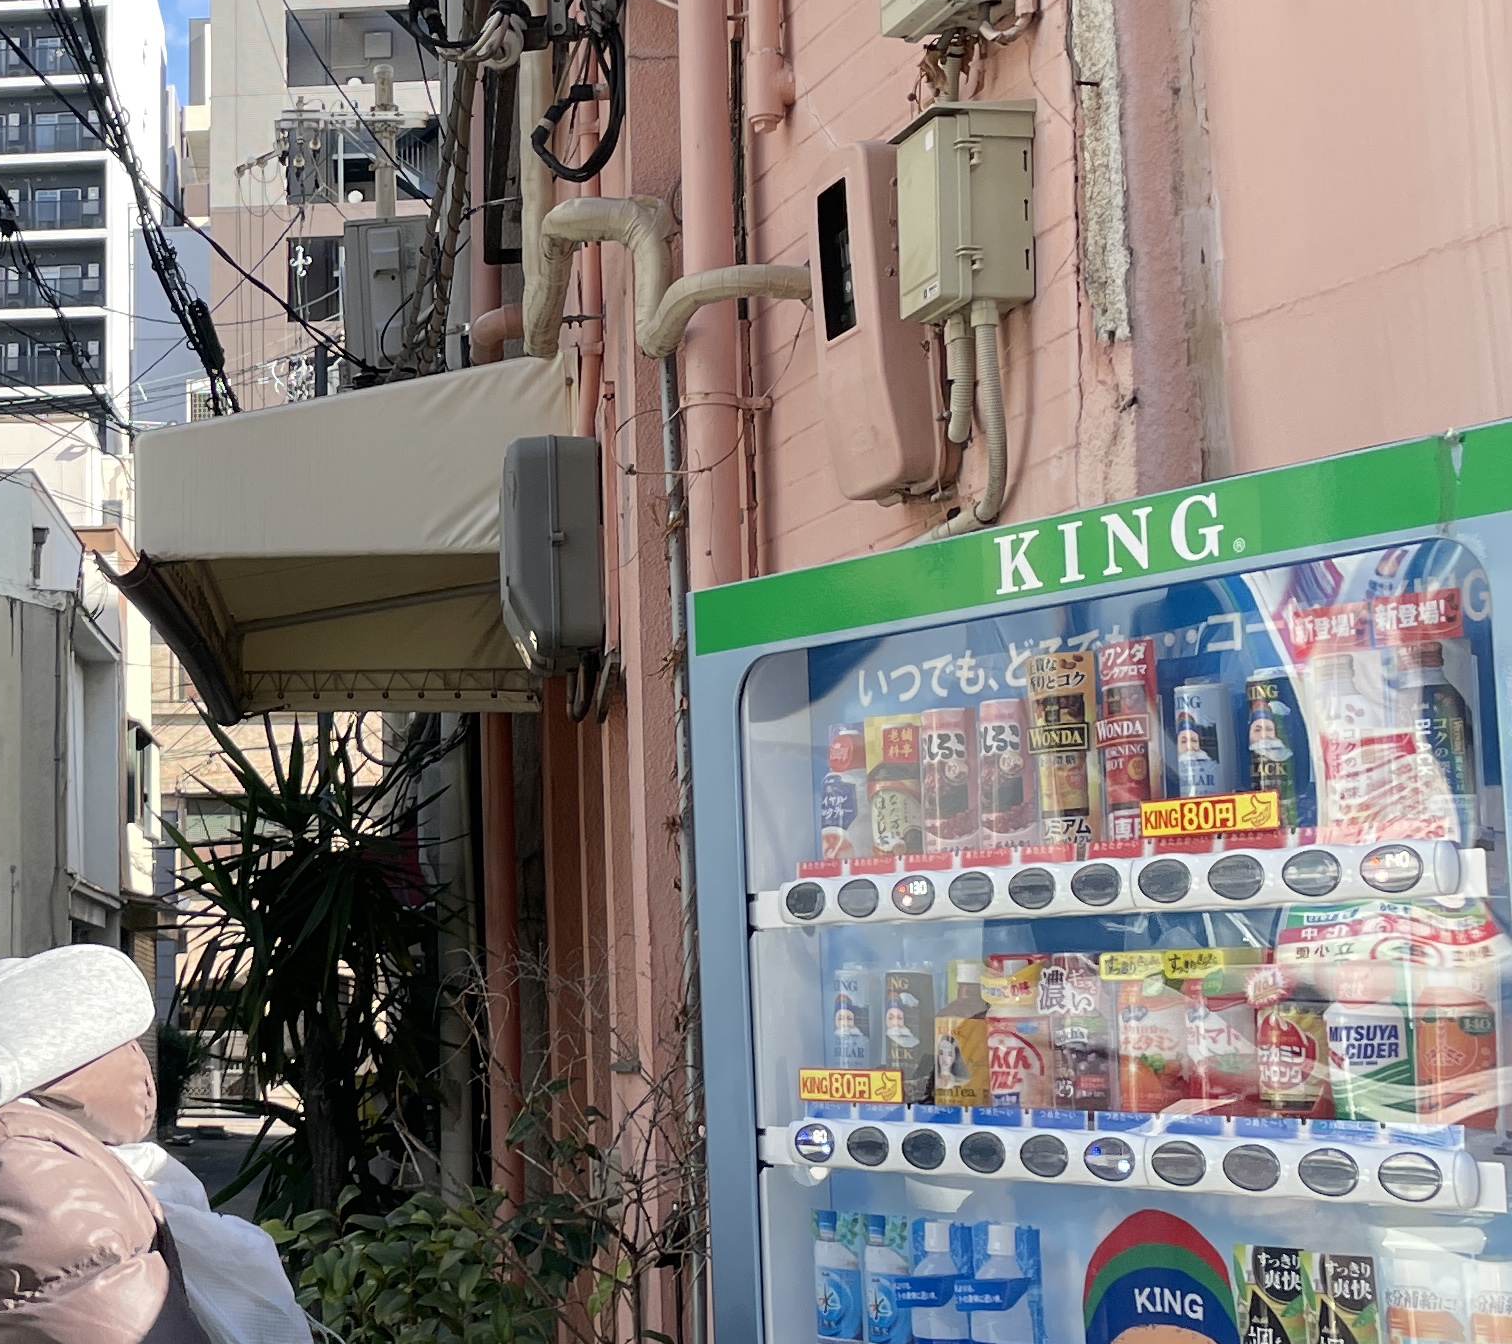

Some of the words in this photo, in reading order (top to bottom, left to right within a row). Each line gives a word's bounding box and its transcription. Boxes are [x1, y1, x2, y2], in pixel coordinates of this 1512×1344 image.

[994, 492, 1224, 596] KING
[1375, 599, 1446, 630] 新登場!
[1030, 726, 1083, 750] WONDA
[1096, 719, 1145, 742] WONDA
[1143, 809, 1179, 832] KING
[1182, 801, 1236, 830] 80円
[1329, 1023, 1400, 1044] MITSUYA
[1346, 1042, 1400, 1060] CIDER
[801, 1076, 829, 1094] KING
[830, 1073, 871, 1099] 80円
[1326, 1259, 1371, 1279] すっきり
[1135, 1285, 1205, 1321] KING
